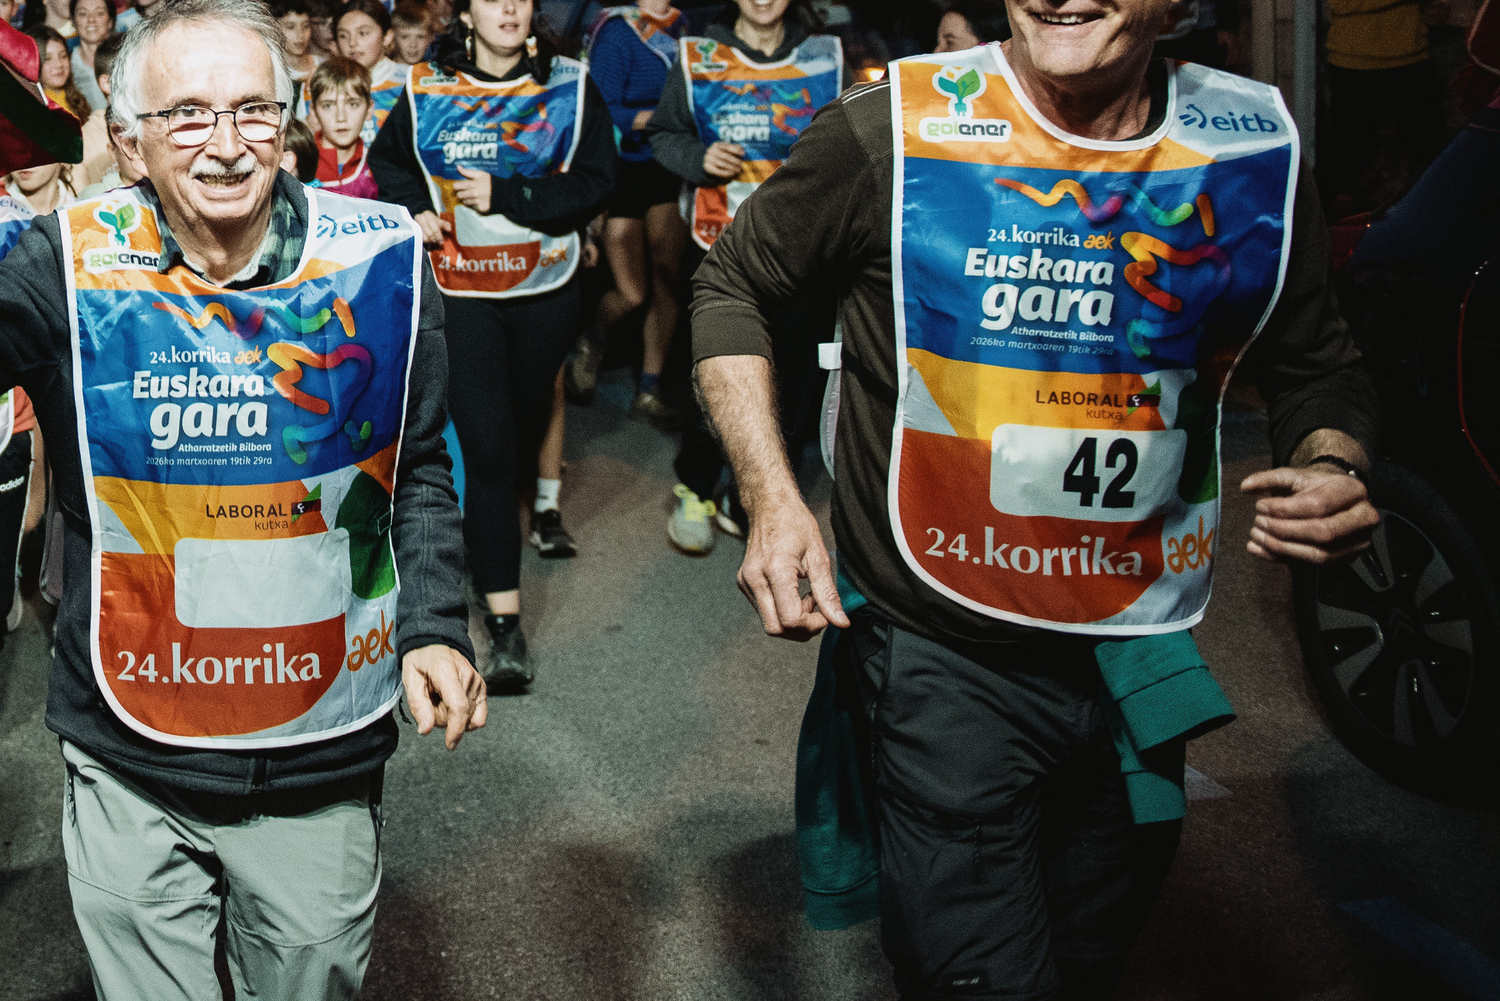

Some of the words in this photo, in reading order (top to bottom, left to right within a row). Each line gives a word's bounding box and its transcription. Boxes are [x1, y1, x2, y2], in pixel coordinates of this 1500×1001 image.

[926, 120, 1007, 137] goiener
[1211, 112, 1279, 133] eitb
[437, 127, 498, 142] Euskara
[718, 126, 770, 142] gara
[443, 142, 498, 164] gara
[341, 212, 400, 235] eitb
[987, 224, 1080, 247] 24.korrika
[1083, 230, 1116, 250] aek
[438, 251, 527, 272] 24.korrika
[964, 247, 1115, 286] Euskara
[980, 283, 1115, 331] gara
[1011, 326, 1077, 340] Atharratzetik
[1079, 331, 1114, 342] Bilbora
[149, 345, 231, 364] 24.korrika
[234, 344, 262, 365] aek
[970, 336, 1005, 348] 2026ko
[1008, 340, 1065, 352] martxoaren
[1068, 344, 1091, 354] 19tik
[1092, 346, 1115, 356] 29ra
[133, 367, 265, 399] Euskara
[1035, 389, 1123, 408] LABORAL
[1086, 407, 1123, 421] kutxa
[149, 401, 268, 450] gara
[178, 443, 237, 453] Atharratzetik
[239, 442, 272, 452] Bilbora
[146, 456, 175, 466] 2026ko
[177, 456, 228, 466] martxoaren
[230, 456, 251, 466] 19tik
[253, 456, 272, 465] 29ra
[1062, 436, 1139, 509] 42
[0, 476, 25, 492] adidas
[206, 503, 287, 519] LABORAL
[254, 519, 289, 531] kutxa
[924, 526, 1143, 577] 24.korrika
[1166, 515, 1215, 575] aek
[346, 609, 395, 672] aek
[116, 641, 323, 685] 24.korrika
